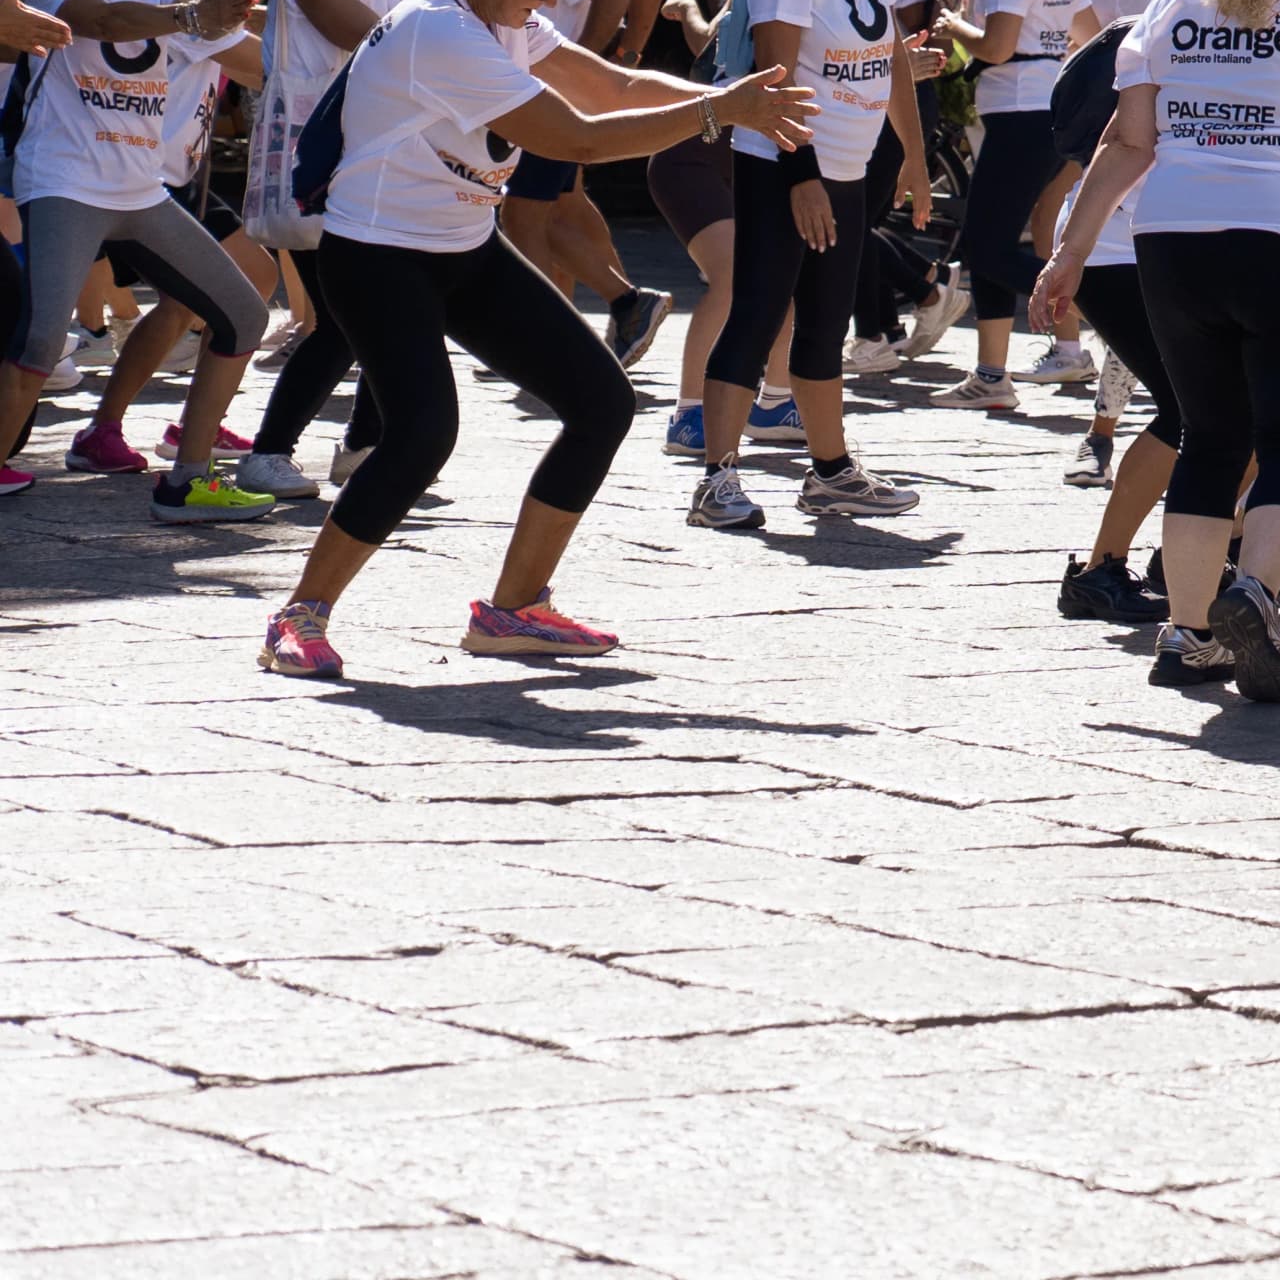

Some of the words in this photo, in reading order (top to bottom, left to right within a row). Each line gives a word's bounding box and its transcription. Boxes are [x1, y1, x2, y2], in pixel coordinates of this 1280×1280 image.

[824, 47, 861, 62] NEW
[1170, 53, 1212, 65] Palestre
[1213, 54, 1252, 65] Italiane
[822, 57, 893, 82] PALERM
[1167, 101, 1276, 124] PALESTRE
